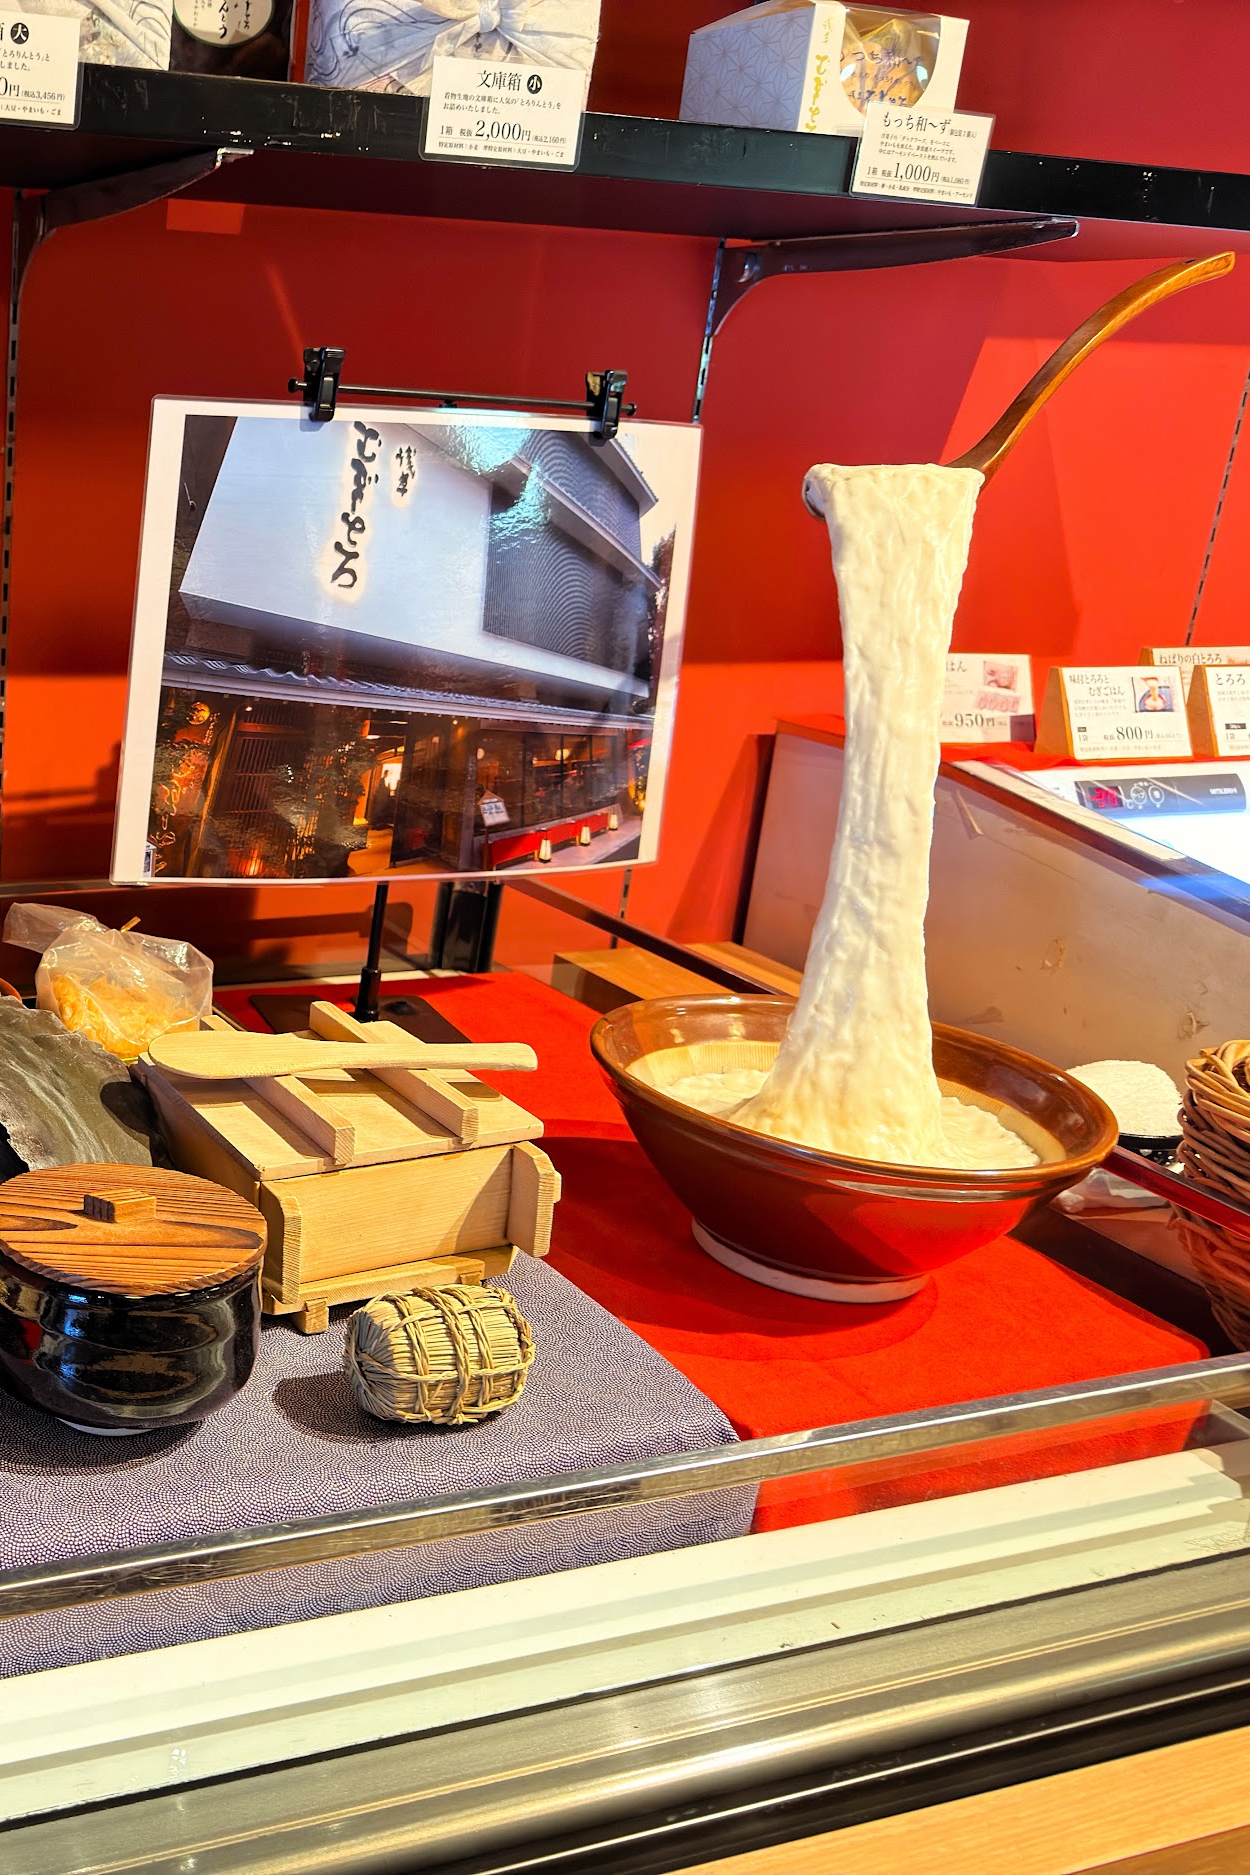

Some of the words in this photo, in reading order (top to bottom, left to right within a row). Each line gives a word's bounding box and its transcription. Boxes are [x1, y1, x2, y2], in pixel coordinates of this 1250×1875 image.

[477, 70, 522, 91] 文庫箱
[475, 120, 531, 141] 2,000円
[894, 162, 940, 182] 1,000円
[1116, 726, 1154, 741] 800円
